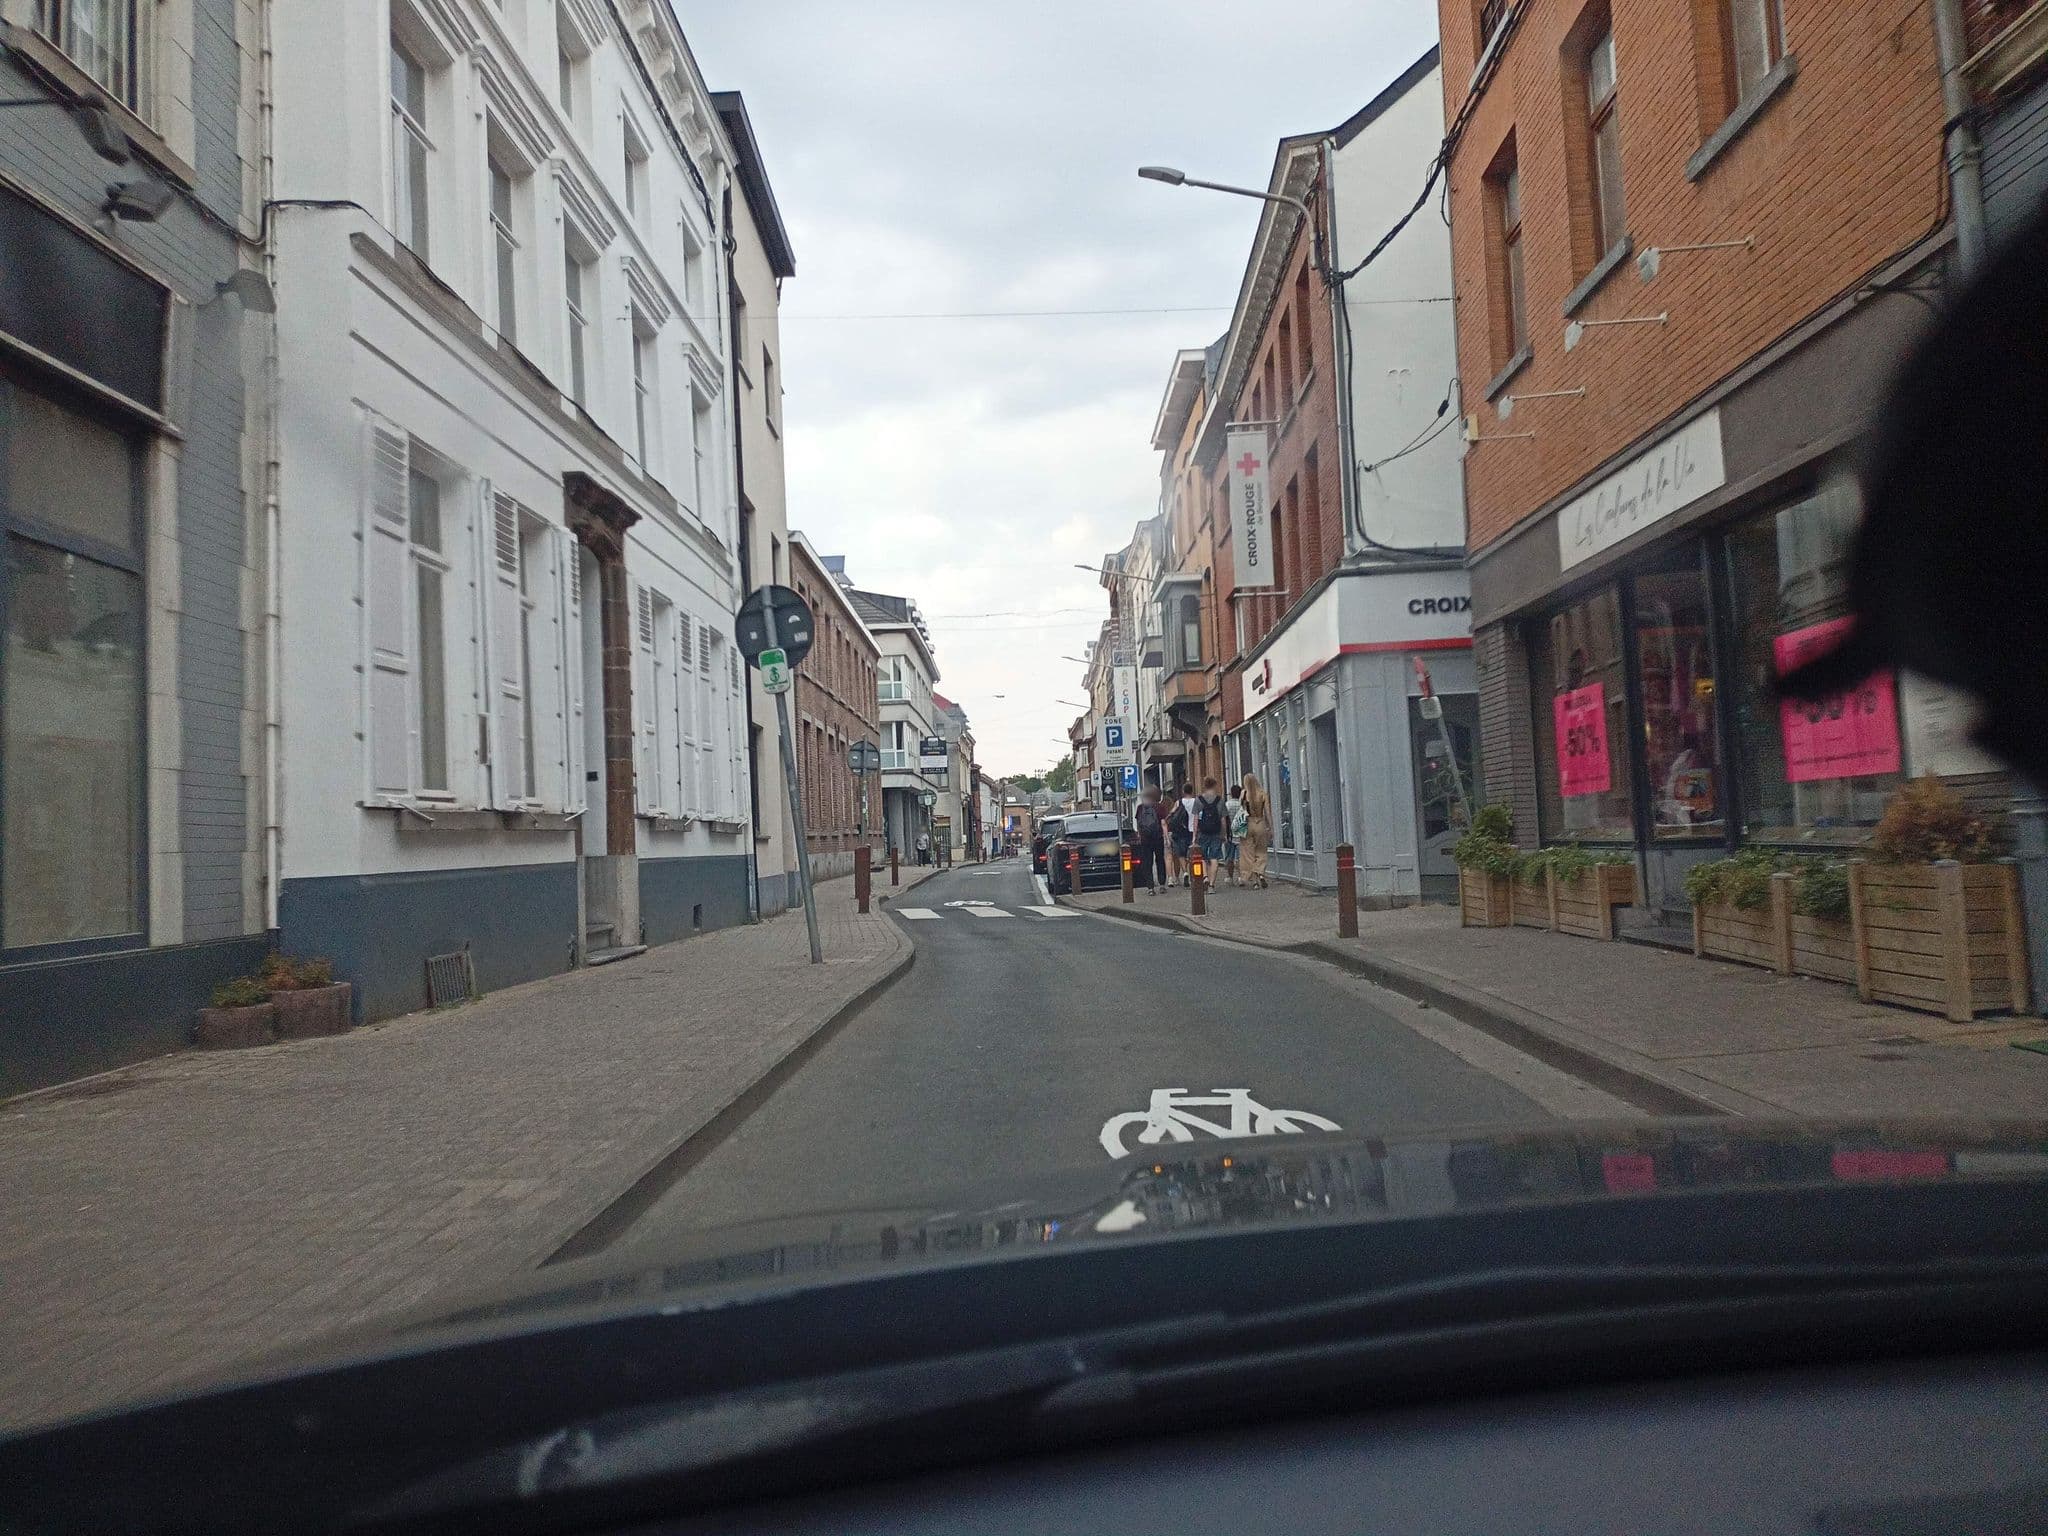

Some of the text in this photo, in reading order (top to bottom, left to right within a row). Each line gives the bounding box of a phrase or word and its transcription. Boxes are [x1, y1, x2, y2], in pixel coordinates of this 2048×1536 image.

[1245, 482, 1258, 567] CROIX-ROUGE
[1104, 717, 1122, 725] ZONE
[1108, 728, 1120, 745] P
[1124, 766, 1135, 780] P
